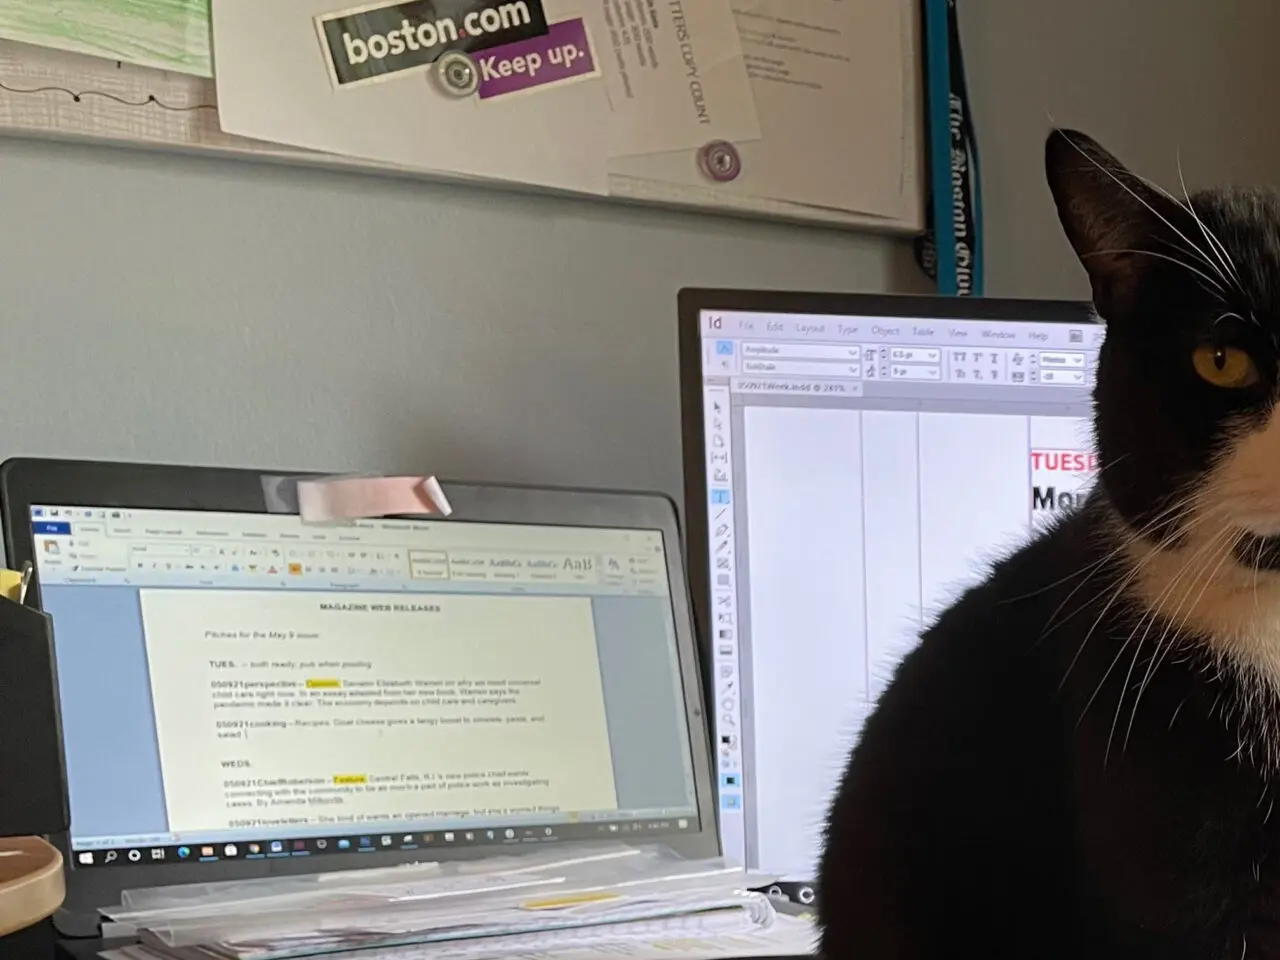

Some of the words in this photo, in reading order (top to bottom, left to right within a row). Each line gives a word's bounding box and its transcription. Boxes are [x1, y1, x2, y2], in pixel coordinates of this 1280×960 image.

[343, 0, 531, 64] boston.com
[479, 51, 542, 81] Keep
[548, 43, 584, 68] up.
[681, 43, 700, 78] COPY
[690, 80, 711, 124] COUNT
[708, 316, 722, 330] Id
[739, 321, 754, 330] File
[767, 322, 784, 332] Edit
[796, 324, 826, 336] Layout
[838, 325, 859, 336] Type
[871, 326, 900, 338] Object
[981, 329, 1017, 341] Window
[1028, 331, 1049, 342] Help
